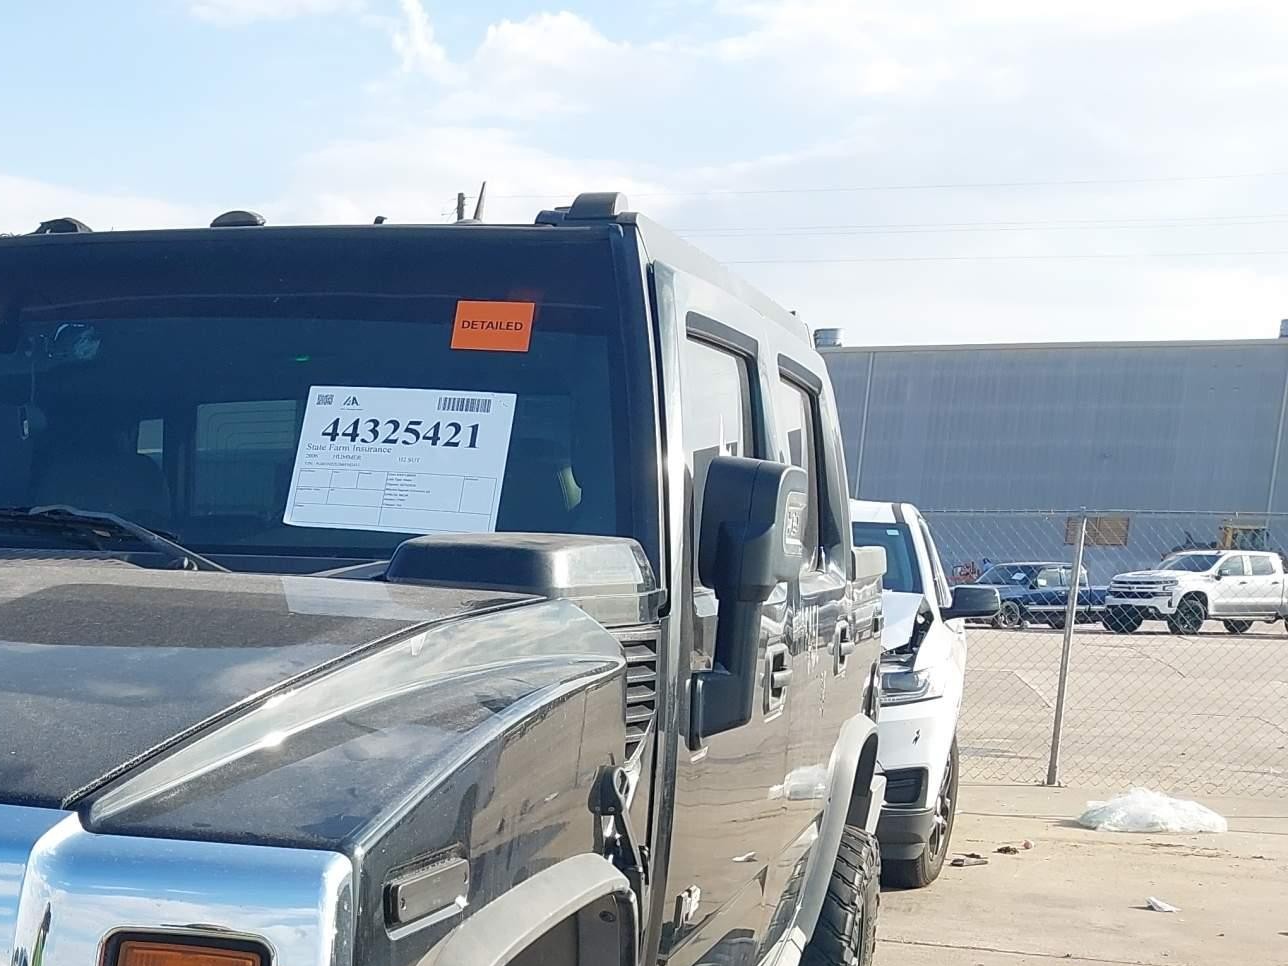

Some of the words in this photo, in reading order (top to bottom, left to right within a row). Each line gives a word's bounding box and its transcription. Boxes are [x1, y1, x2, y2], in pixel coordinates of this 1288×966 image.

[461, 319, 523, 331] DETAILED
[321, 417, 480, 449] 44325421
[306, 443, 326, 451] State
[328, 443, 350, 452] Farm
[352, 444, 392, 453] Insurance
